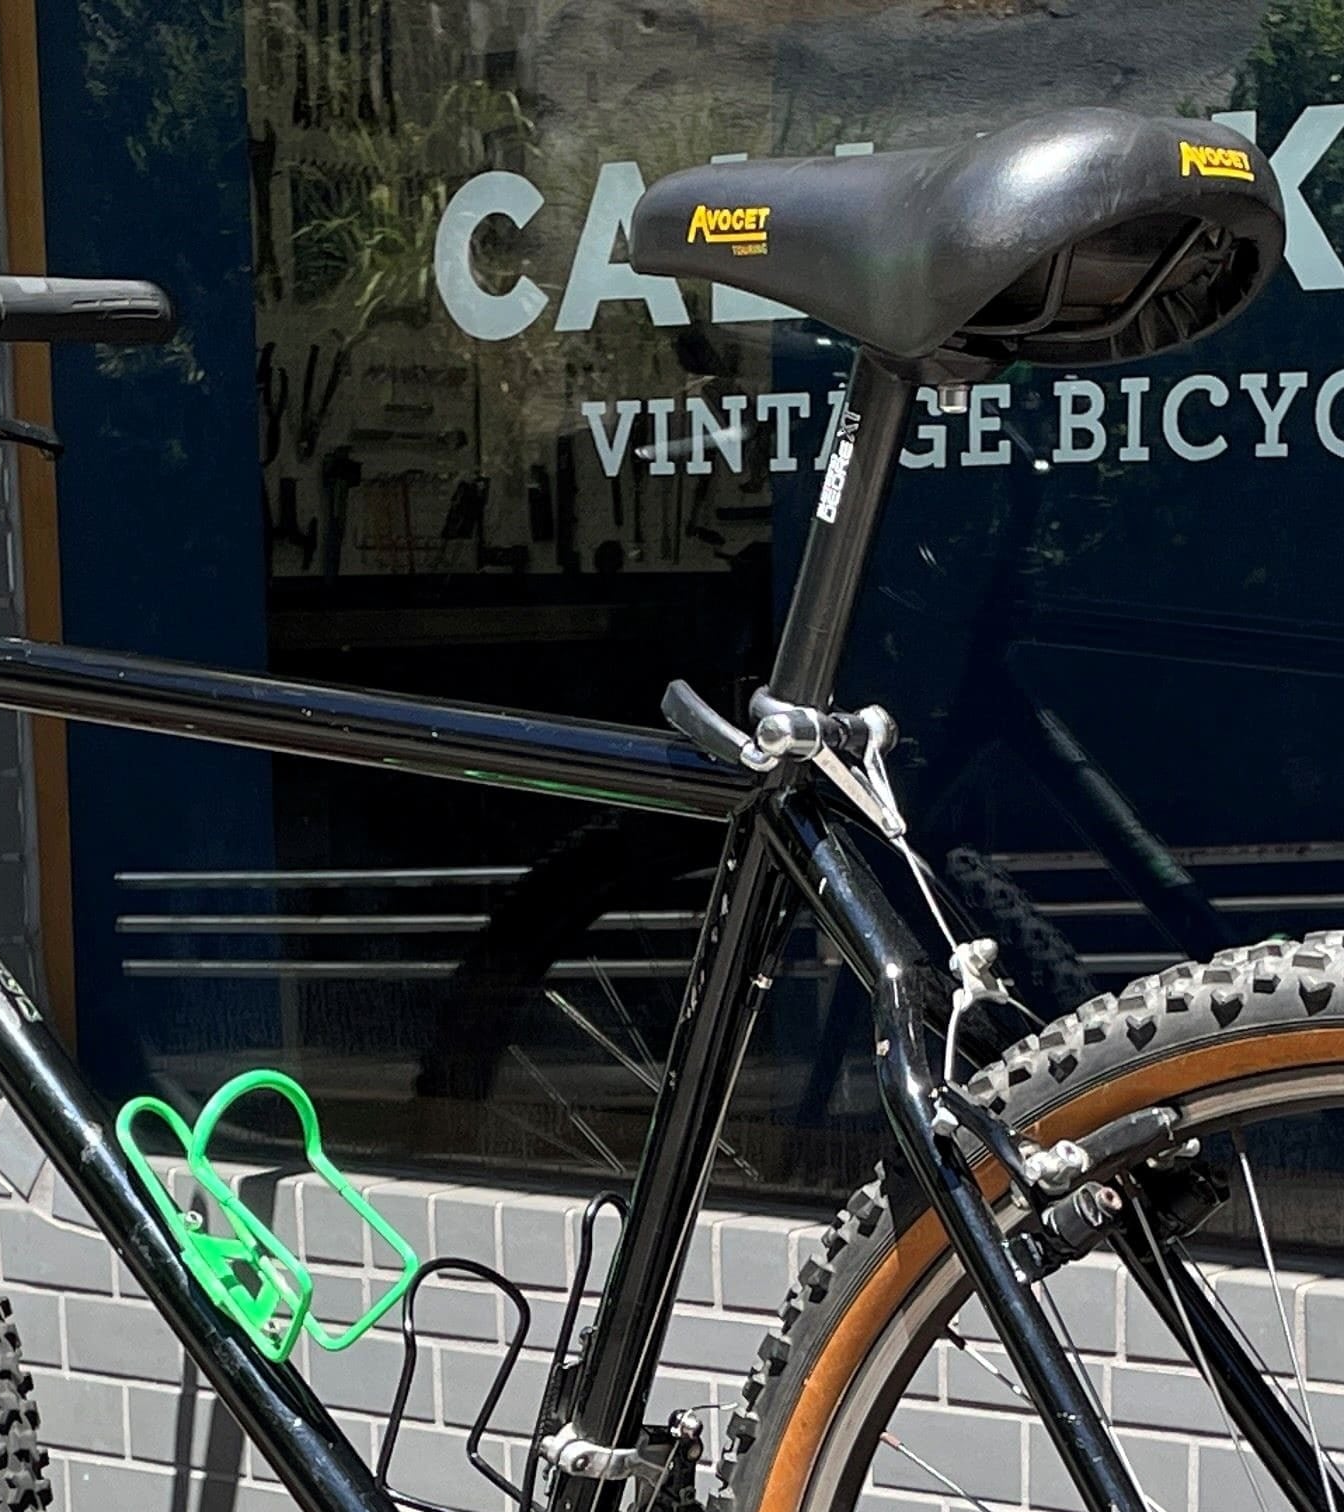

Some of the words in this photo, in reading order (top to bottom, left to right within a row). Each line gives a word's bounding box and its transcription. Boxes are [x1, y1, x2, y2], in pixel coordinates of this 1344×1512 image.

[1178, 141, 1255, 182] AVOCET
[687, 204, 770, 243] AVOCET
[836, 401, 862, 443] XT
